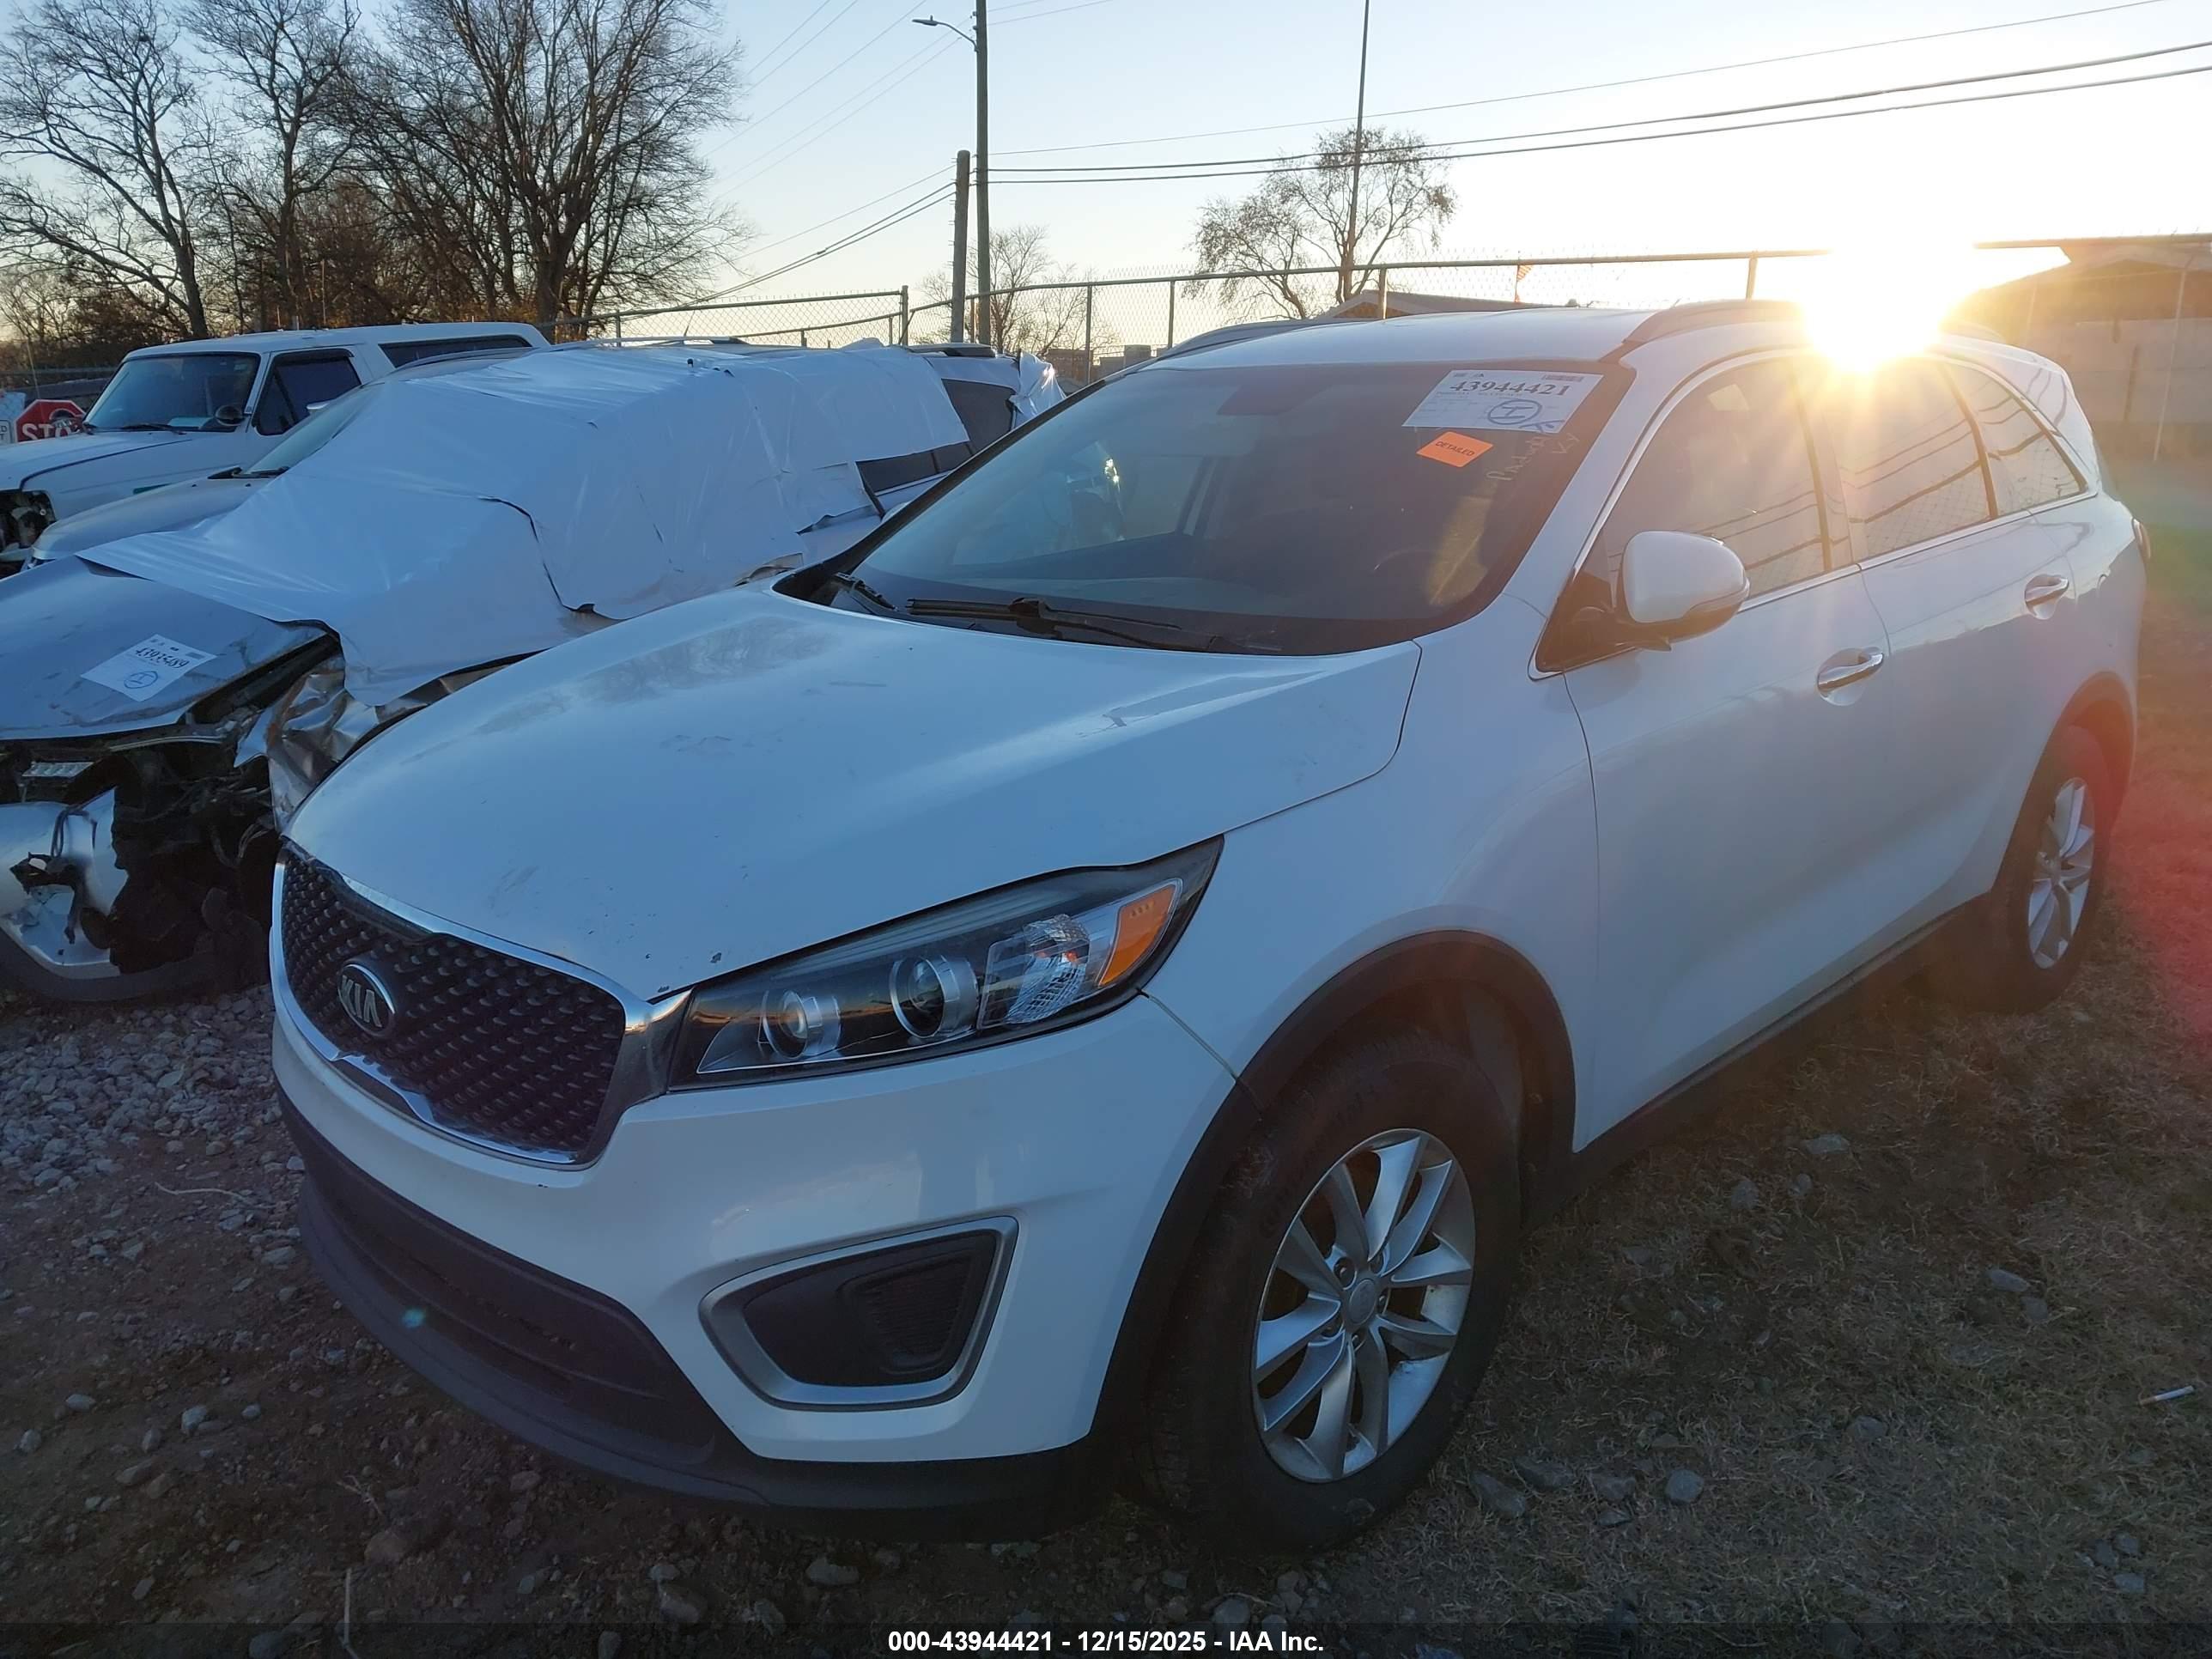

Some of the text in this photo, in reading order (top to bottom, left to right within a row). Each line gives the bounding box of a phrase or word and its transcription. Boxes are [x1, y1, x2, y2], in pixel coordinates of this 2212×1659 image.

[1449, 380, 1571, 396] 43944421
[1435, 441, 1475, 457] DETAILED
[341, 975, 383, 1028] KIA
